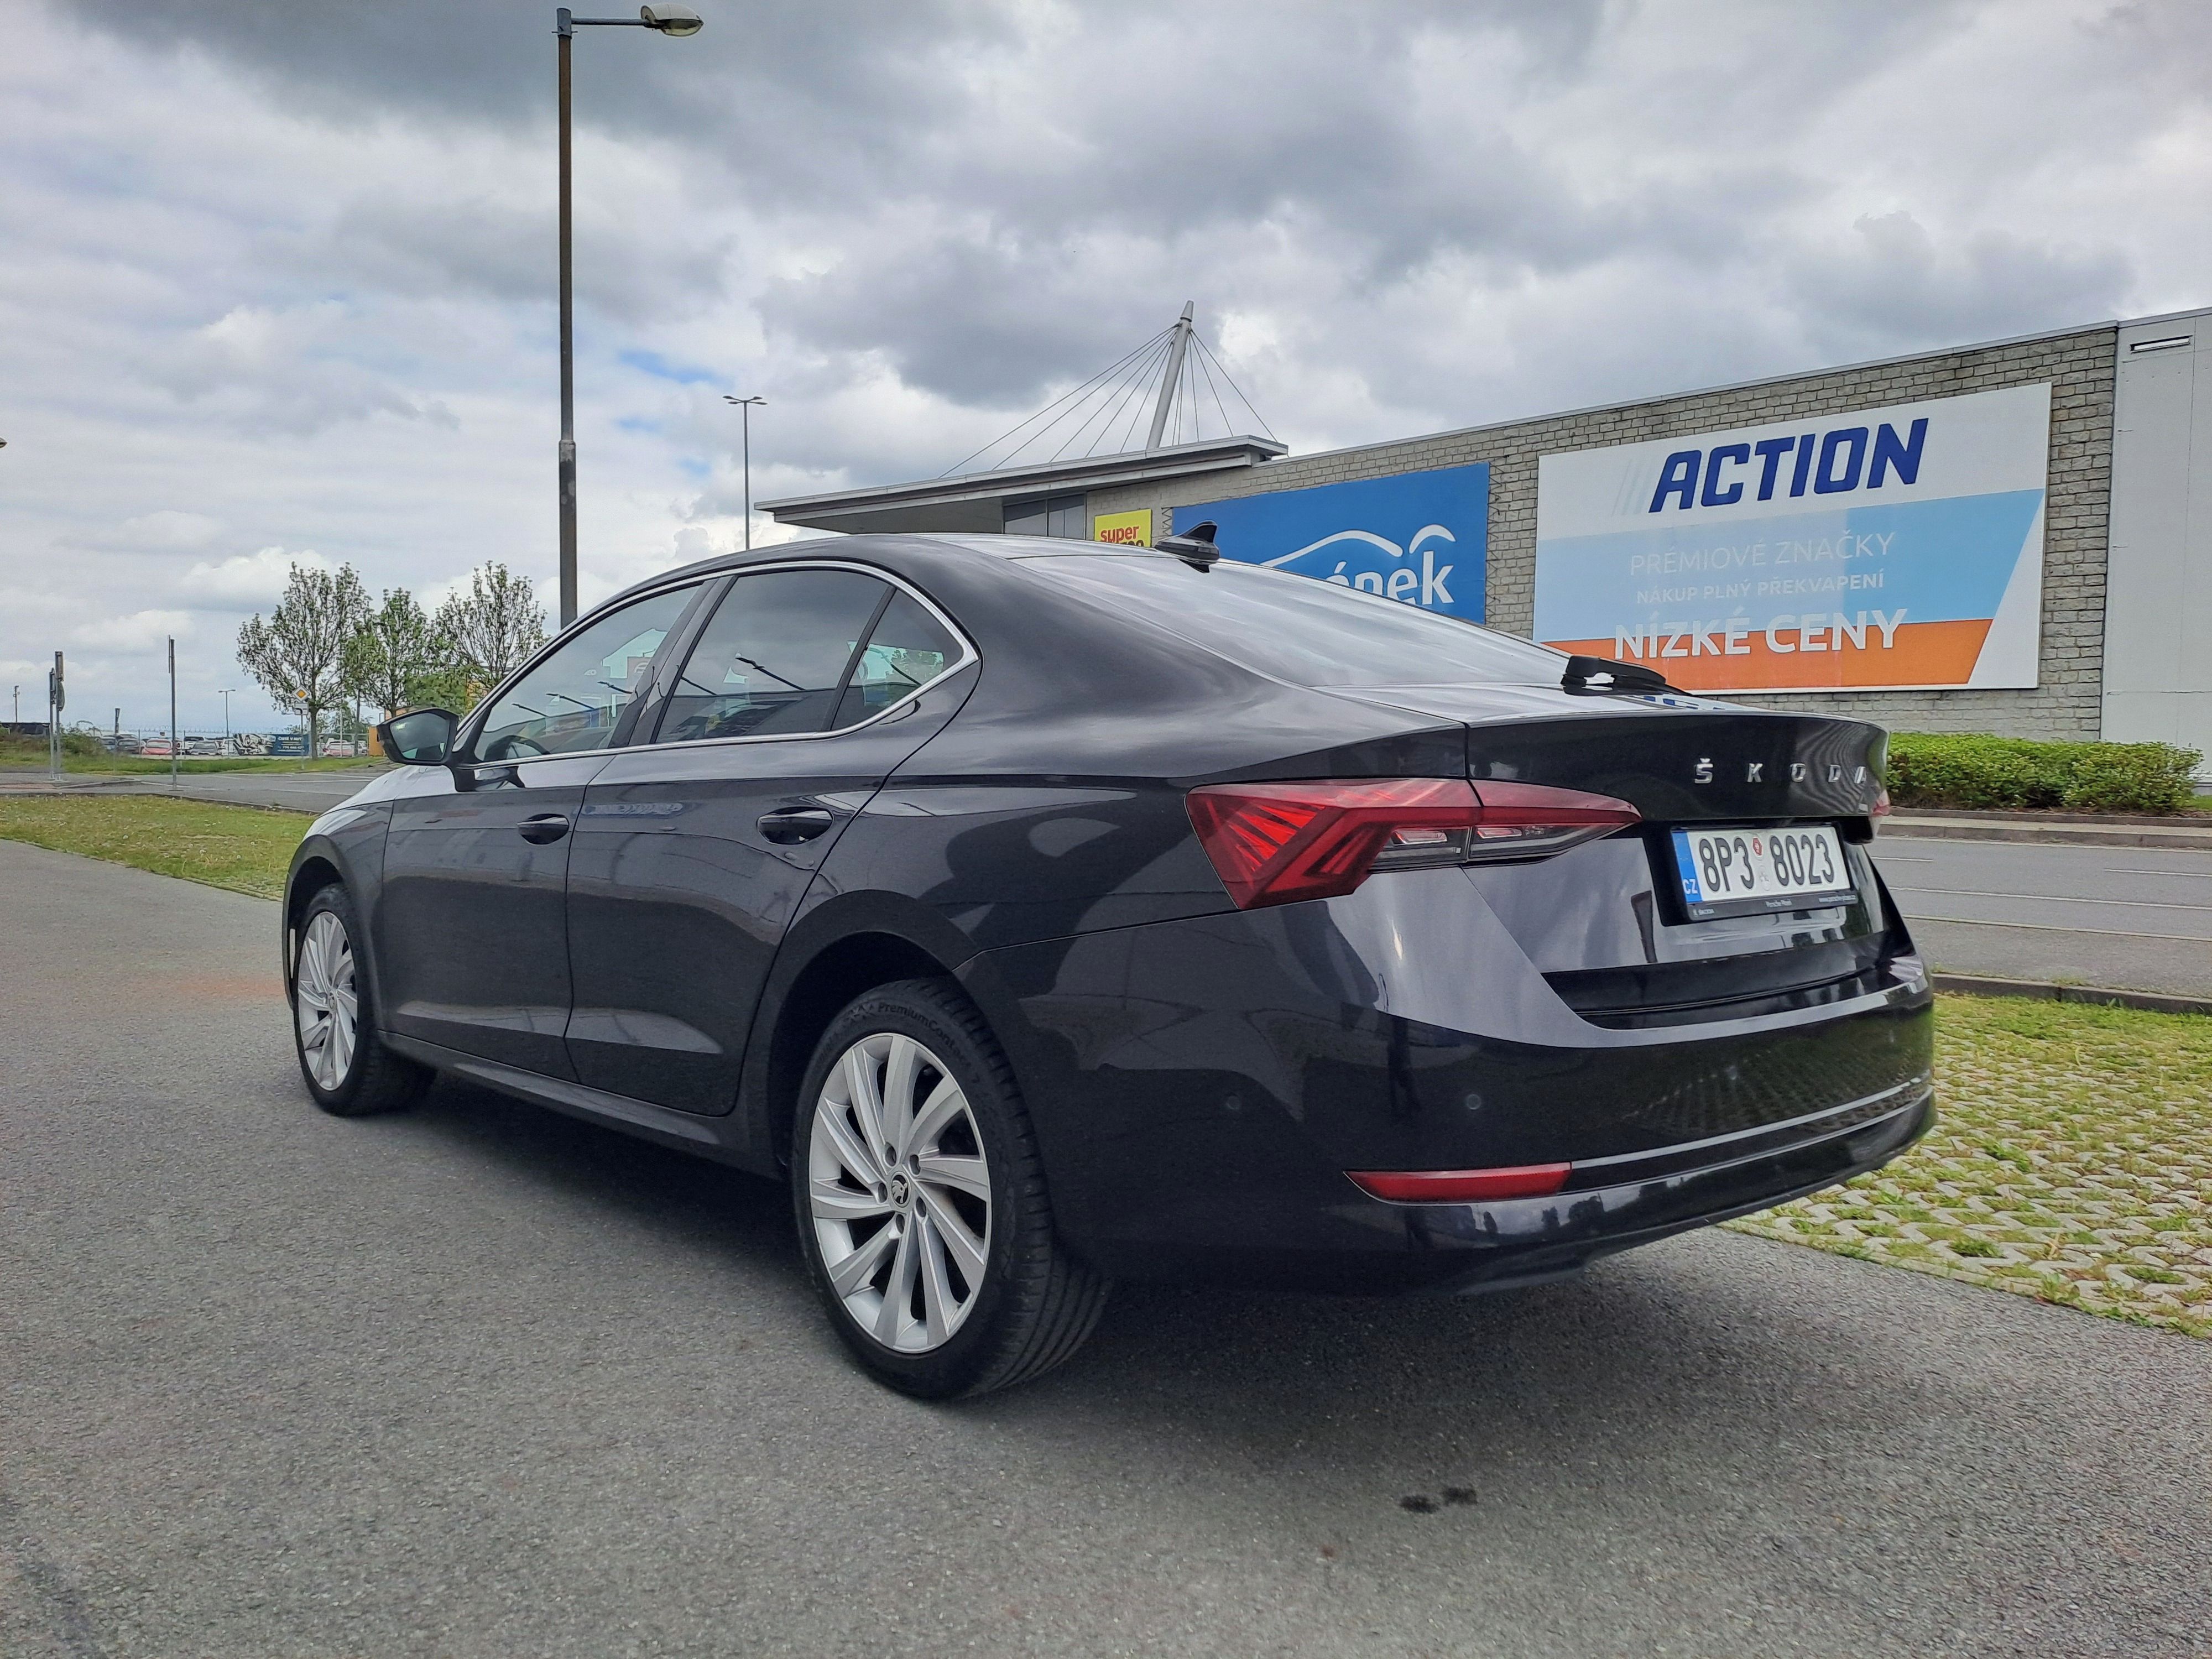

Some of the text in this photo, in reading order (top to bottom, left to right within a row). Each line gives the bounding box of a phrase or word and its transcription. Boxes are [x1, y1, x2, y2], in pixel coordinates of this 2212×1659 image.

[1648, 418, 1929, 514] ACTION
[1100, 525, 1140, 544] super
[1630, 529, 1896, 576] PRÉMIOVÉ ZNAČKY
[1636, 568, 1884, 604] NÁKUP PLNÝ PŘEKVAPENÍ
[1614, 606, 1908, 659] NÍZKÉ CENY
[1694, 758, 1867, 784] ŠKODA
[1699, 834, 1834, 892] 8P3 8023
[1682, 878, 1699, 895] CZ
